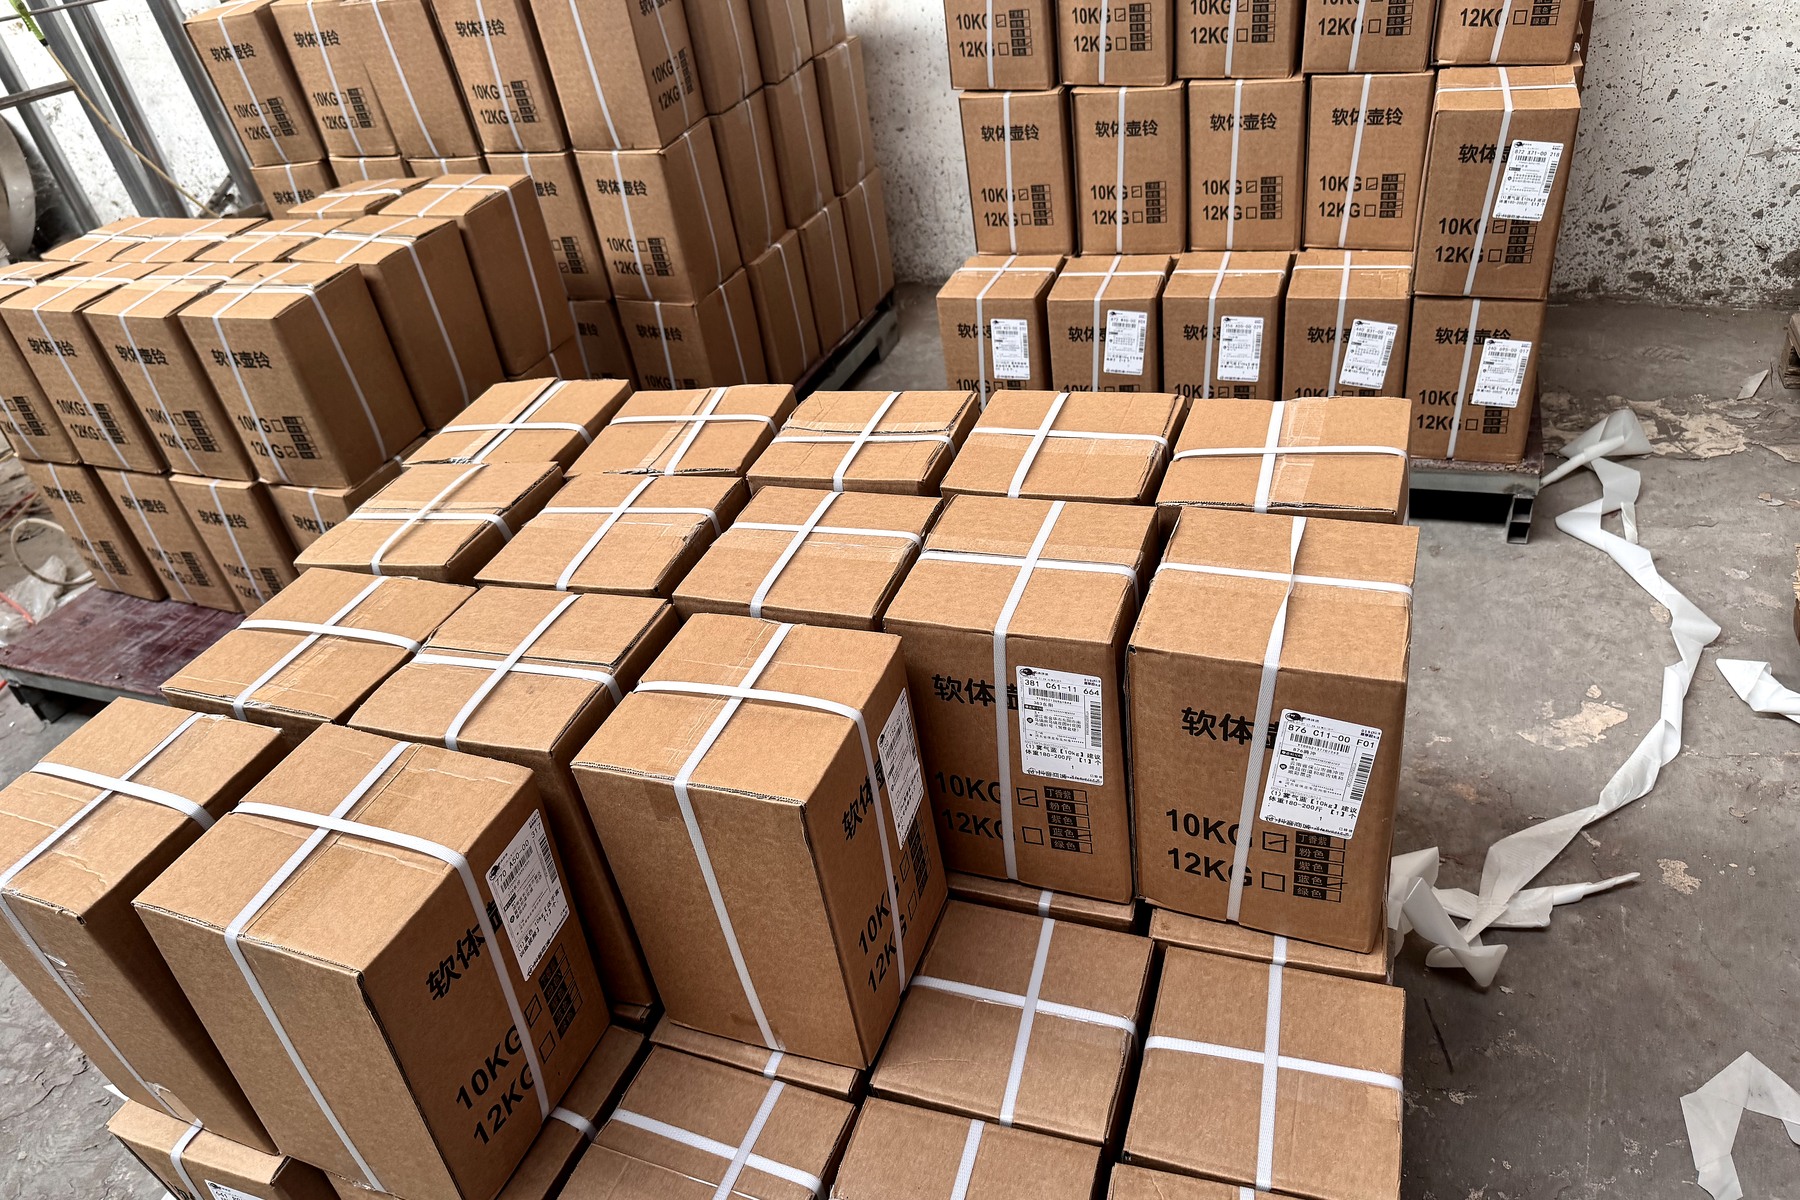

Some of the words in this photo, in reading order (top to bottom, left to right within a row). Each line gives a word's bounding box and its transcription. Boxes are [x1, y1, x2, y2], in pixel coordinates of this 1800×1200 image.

[1191, 27, 1229, 44] 12KG
[651, 59, 674, 85] 10KG
[313, 92, 339, 107] 10KG
[472, 84, 500, 100] 10KG
[658, 85, 680, 111] 12KG
[234, 103, 260, 117] 10KG
[480, 110, 510, 124] 12KG
[1332, 107, 1404, 126] 软体壶铃
[322, 115, 348, 129] 12KG
[1095, 119, 1159, 138] 软体壶铃
[1210, 113, 1277, 131] 软体壶铃
[245, 126, 272, 140] 12KG
[981, 123, 1040, 142] 软体壶铃
[596, 179, 648, 196] 软体壶铃
[1202, 180, 1242, 195] 10KG
[1319, 176, 1362, 192] 10KG
[1202, 205, 1242, 221] 12KG
[1319, 202, 1360, 218] 12KG
[606, 237, 635, 253] 10KG
[211, 349, 272, 369] 软体壶铃
[56, 399, 86, 416] 10KG
[70, 424, 99, 440] 12KG
[1024, 679, 1039, 687] 381
[1045, 682, 1077, 692] C61-11
[1083, 687, 1099, 696] 664
[1287, 723, 1307, 734] 876
[1312, 729, 1351, 743] C11-00
[1356, 738, 1375, 748] F01
[1050, 802, 1072, 812] 粉色
[1052, 828, 1075, 837] 蓝色
[494, 867, 507, 887] 770
[508, 837, 529, 869] A50-00
[530, 821, 542, 839] 317
[1299, 848, 1324, 859] 粉色
[1298, 861, 1323, 872] 紫色
[1297, 875, 1322, 886] 蓝色
[1297, 888, 1322, 898] 绿色
[455, 1024, 522, 1111] 10KG
[473, 1063, 536, 1145] 12KG
